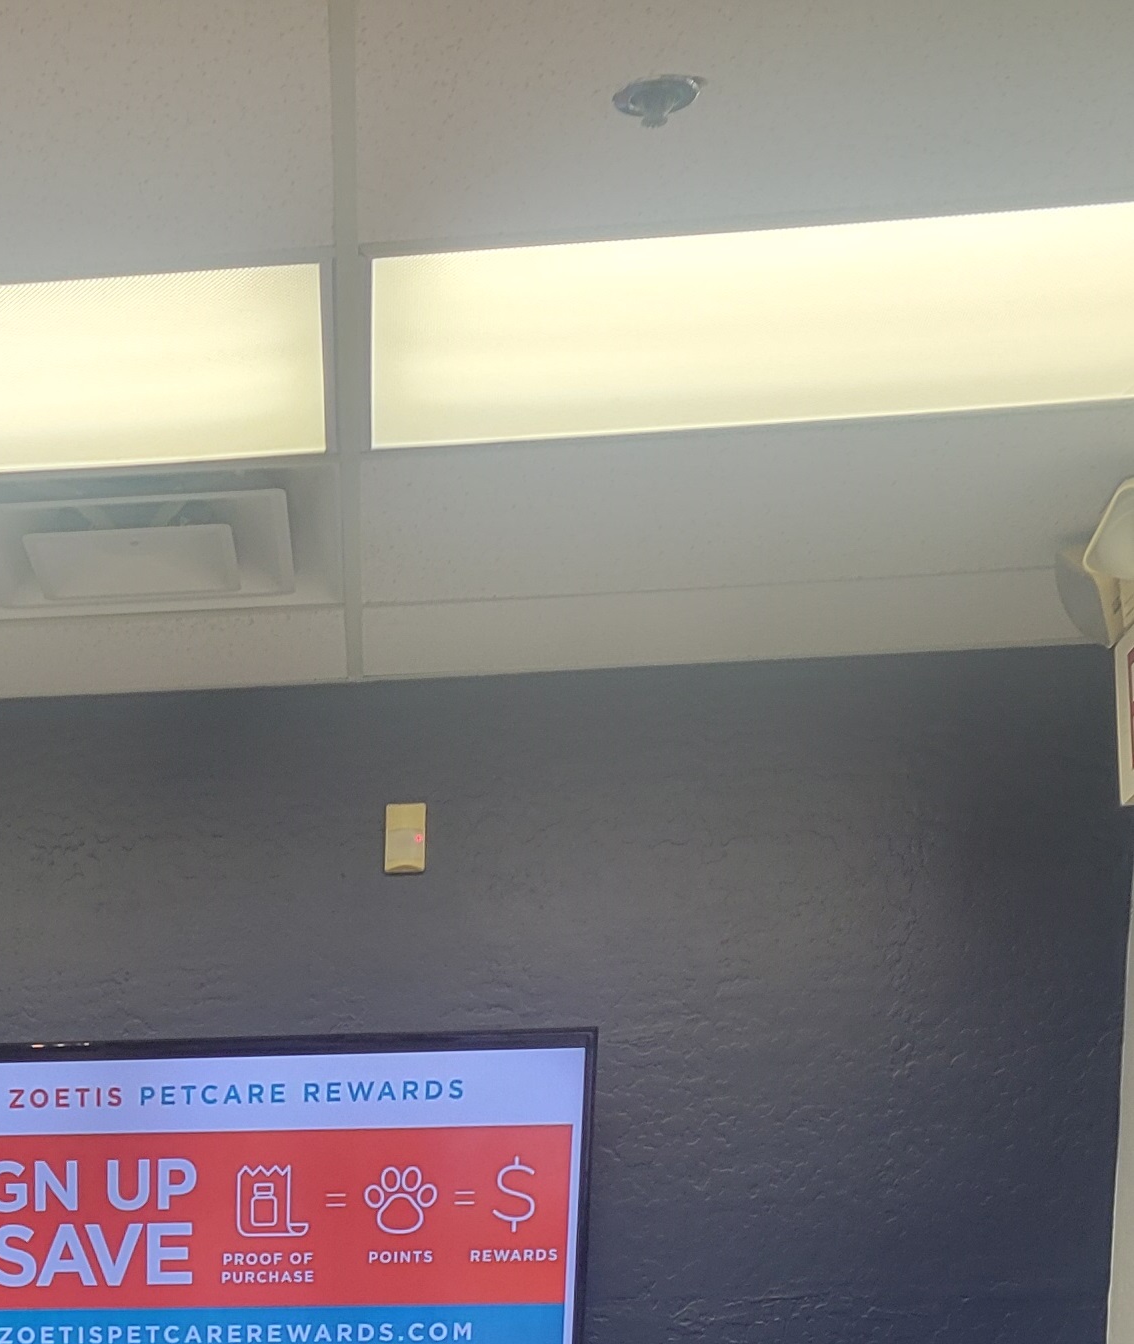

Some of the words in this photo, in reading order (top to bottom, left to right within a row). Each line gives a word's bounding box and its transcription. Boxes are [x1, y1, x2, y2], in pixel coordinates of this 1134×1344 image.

[9, 1087, 122, 1109] ZOETIS
[140, 1083, 286, 1106] PETCARE
[303, 1079, 464, 1103] REWARDS
[107, 1158, 198, 1211] UP
[222, 1253, 283, 1266] PROOF
[289, 1252, 314, 1265] OF
[368, 1250, 433, 1264] POINTS
[470, 1249, 558, 1263] REWARDS
[221, 1270, 314, 1284] PURCHASE
